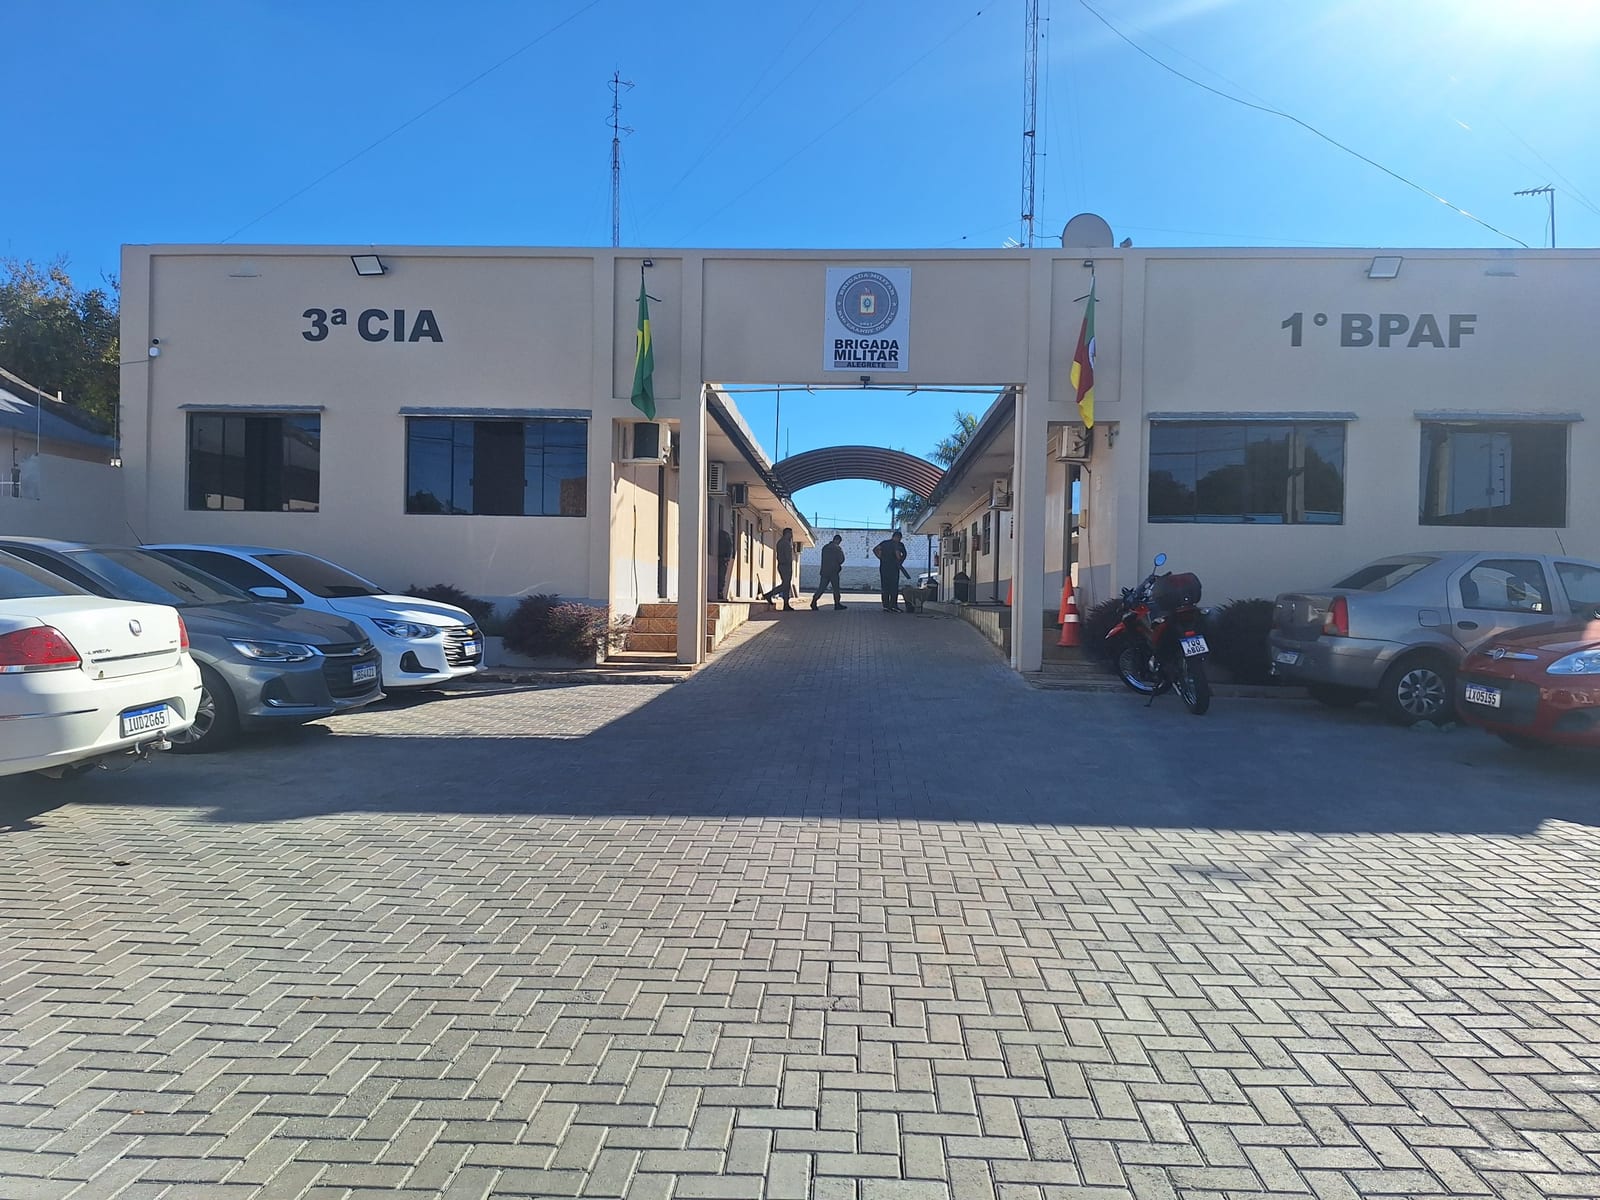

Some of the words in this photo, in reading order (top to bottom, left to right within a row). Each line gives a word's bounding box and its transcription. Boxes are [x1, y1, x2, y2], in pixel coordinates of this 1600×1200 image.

[357, 308, 443, 342] CIA
[1340, 313, 1477, 348] BPAF
[834, 339, 899, 350] BRIGADA
[834, 350, 899, 361] MILITAR
